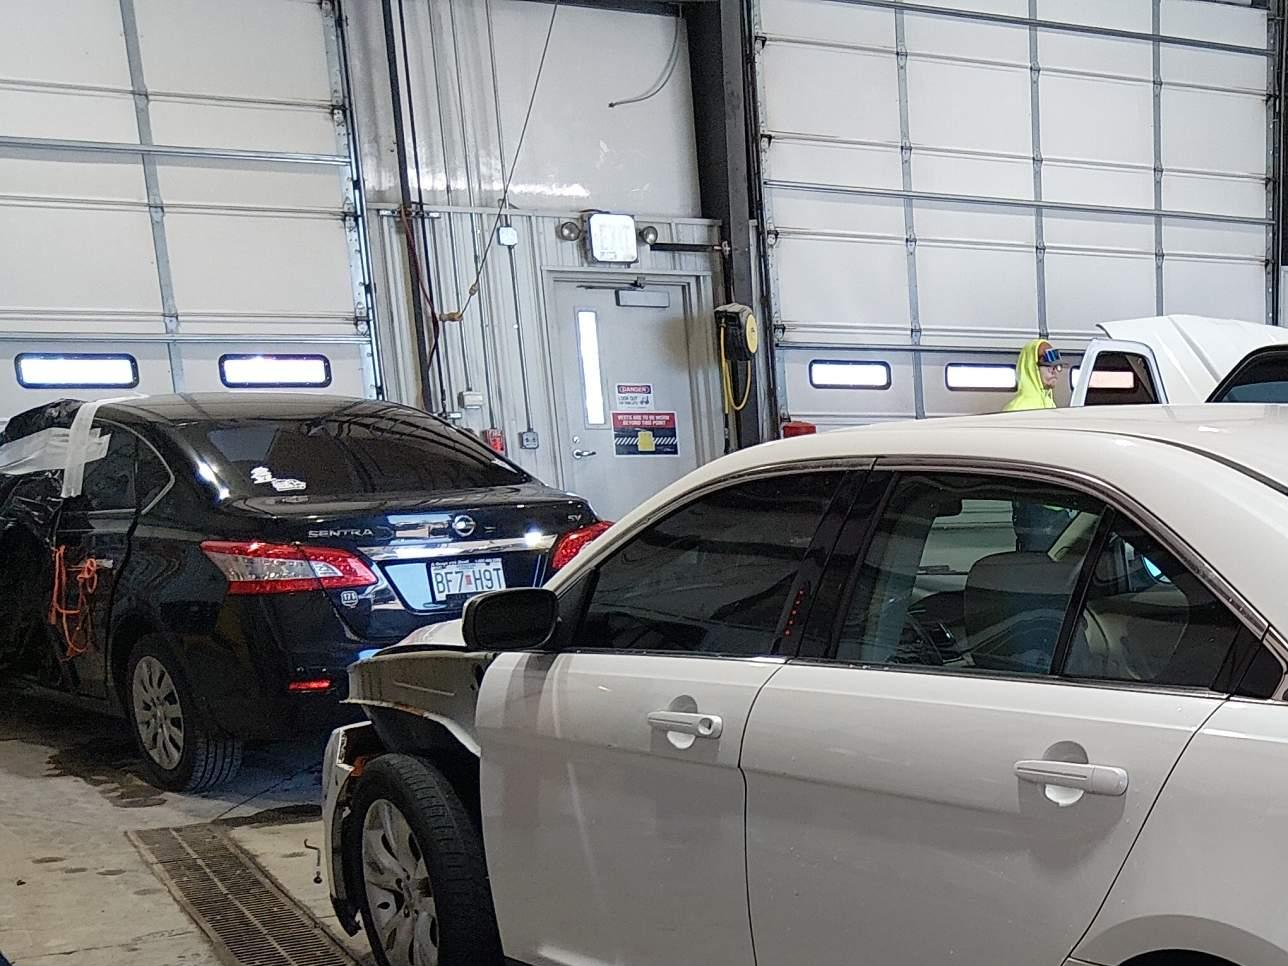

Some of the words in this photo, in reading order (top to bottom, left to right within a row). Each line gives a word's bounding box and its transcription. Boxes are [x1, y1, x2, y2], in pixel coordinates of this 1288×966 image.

[307, 527, 374, 538] SENTRA
[433, 570, 465, 594] BF7
[471, 567, 503, 591] H9T
